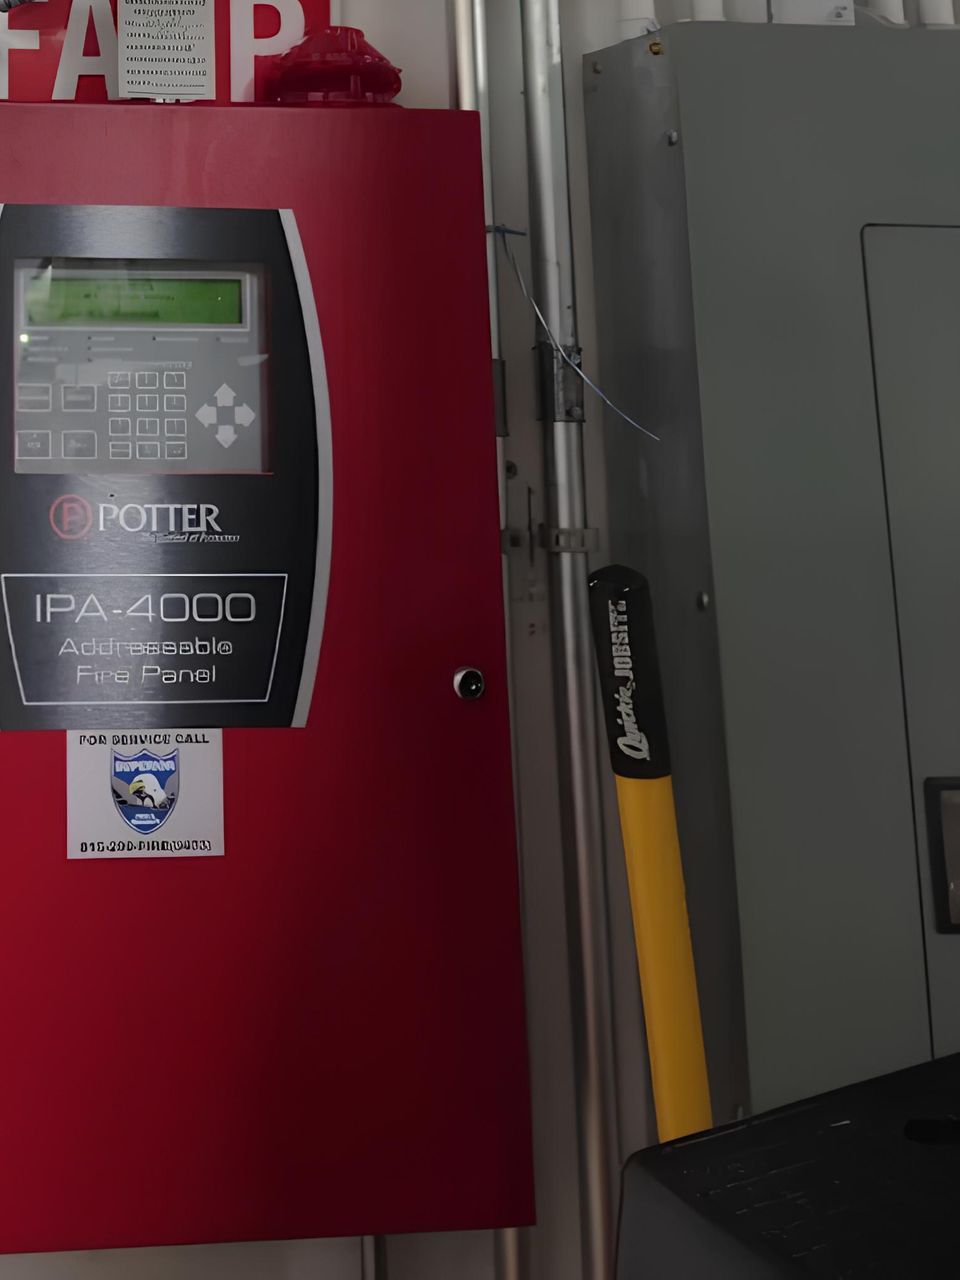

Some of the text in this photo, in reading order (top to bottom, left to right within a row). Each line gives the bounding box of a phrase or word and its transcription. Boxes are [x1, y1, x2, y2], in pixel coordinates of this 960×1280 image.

[98, 503, 222, 532] POTTER
[35, 593, 256, 623] IPA-4000
[77, 664, 216, 685] Fire Panel
[175, 733, 210, 744] CALL
